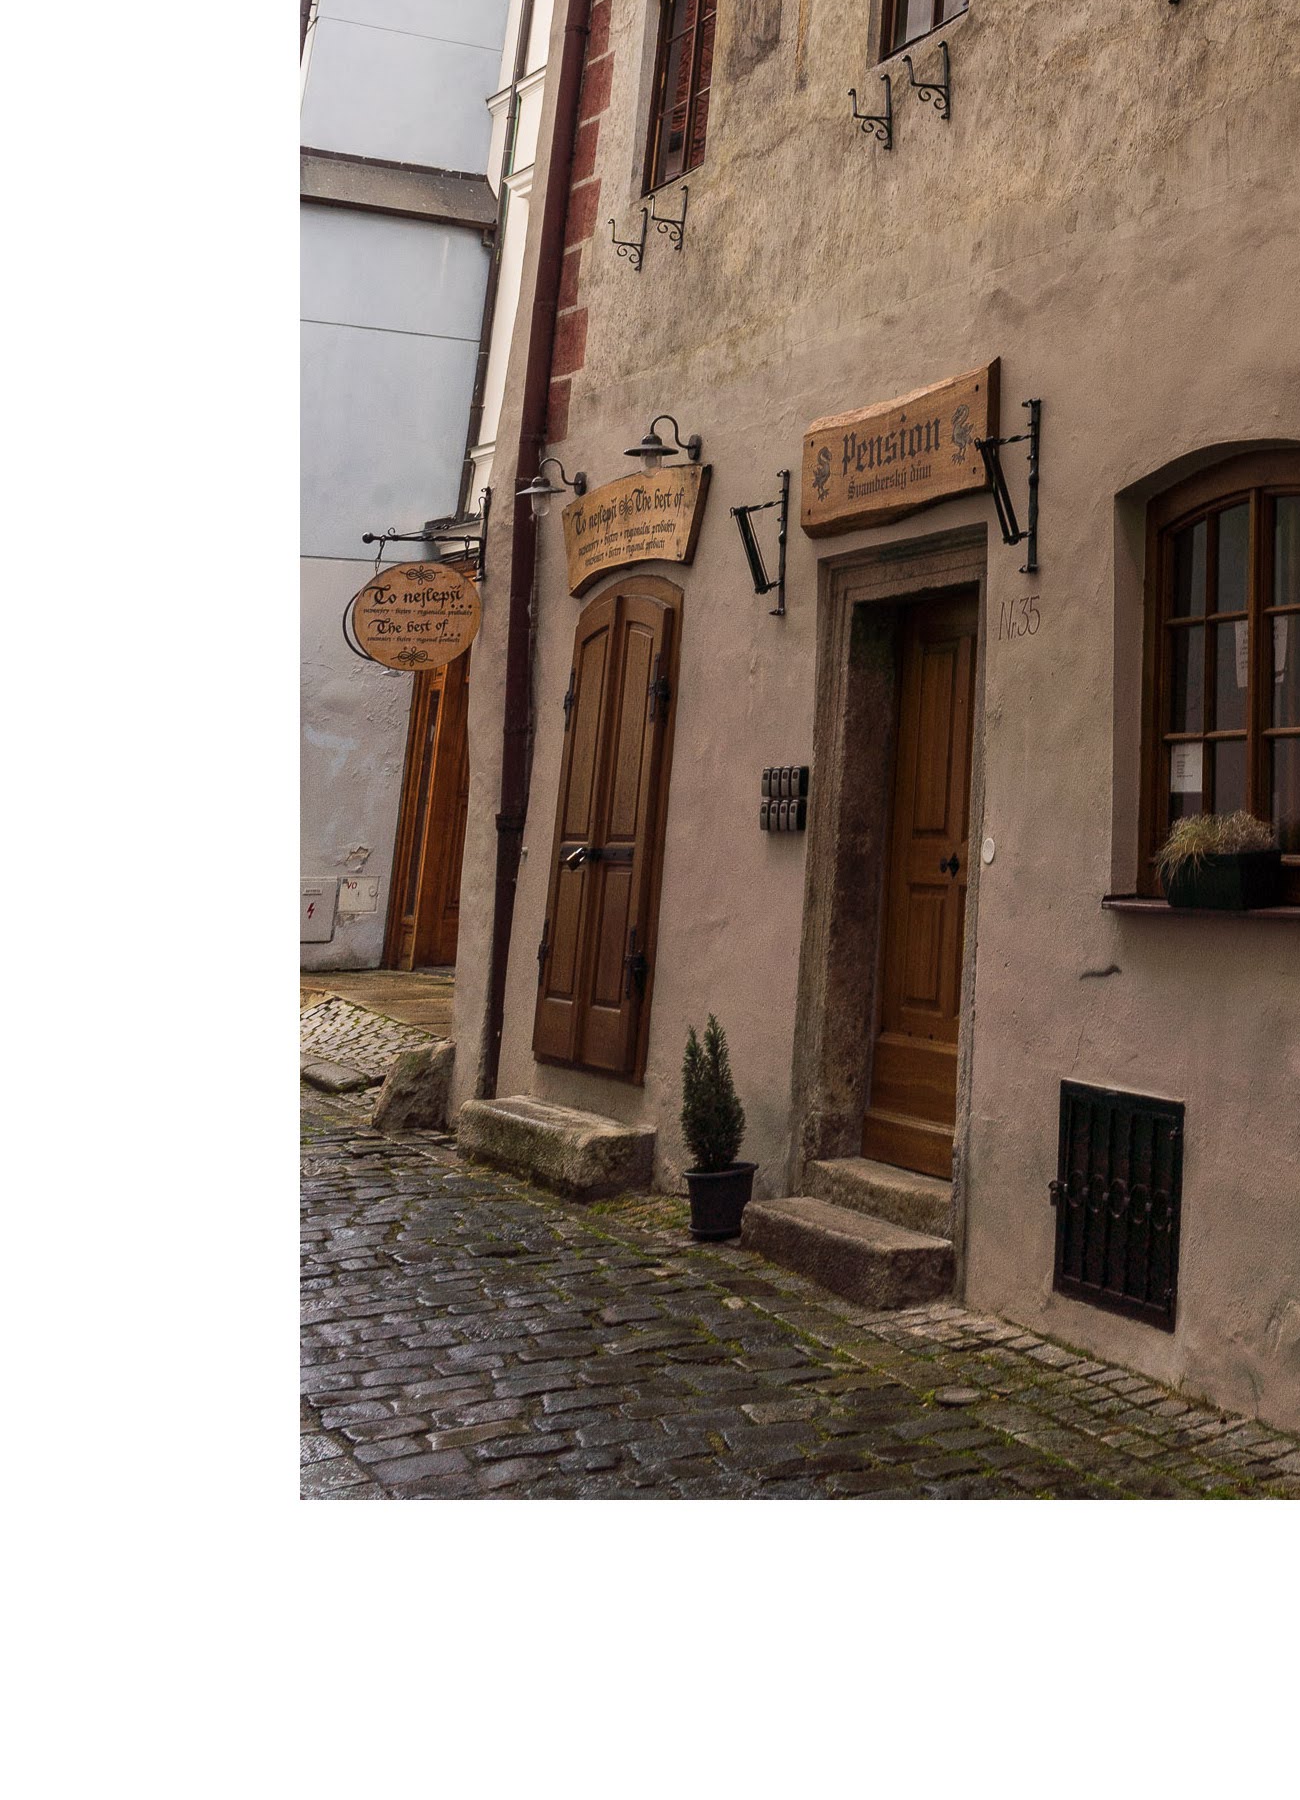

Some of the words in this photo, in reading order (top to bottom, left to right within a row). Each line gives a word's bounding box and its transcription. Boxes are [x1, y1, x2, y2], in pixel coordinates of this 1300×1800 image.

[841, 414, 941, 477] Pension
[847, 467, 907, 500] Švamberský
[910, 460, 932, 483] dům
[571, 506, 586, 535] To
[589, 497, 617, 533] nejlepší
[630, 486, 652, 513] The
[654, 486, 672, 512] best
[362, 584, 397, 607] To
[368, 618, 402, 636] The
[407, 620, 432, 634] best
